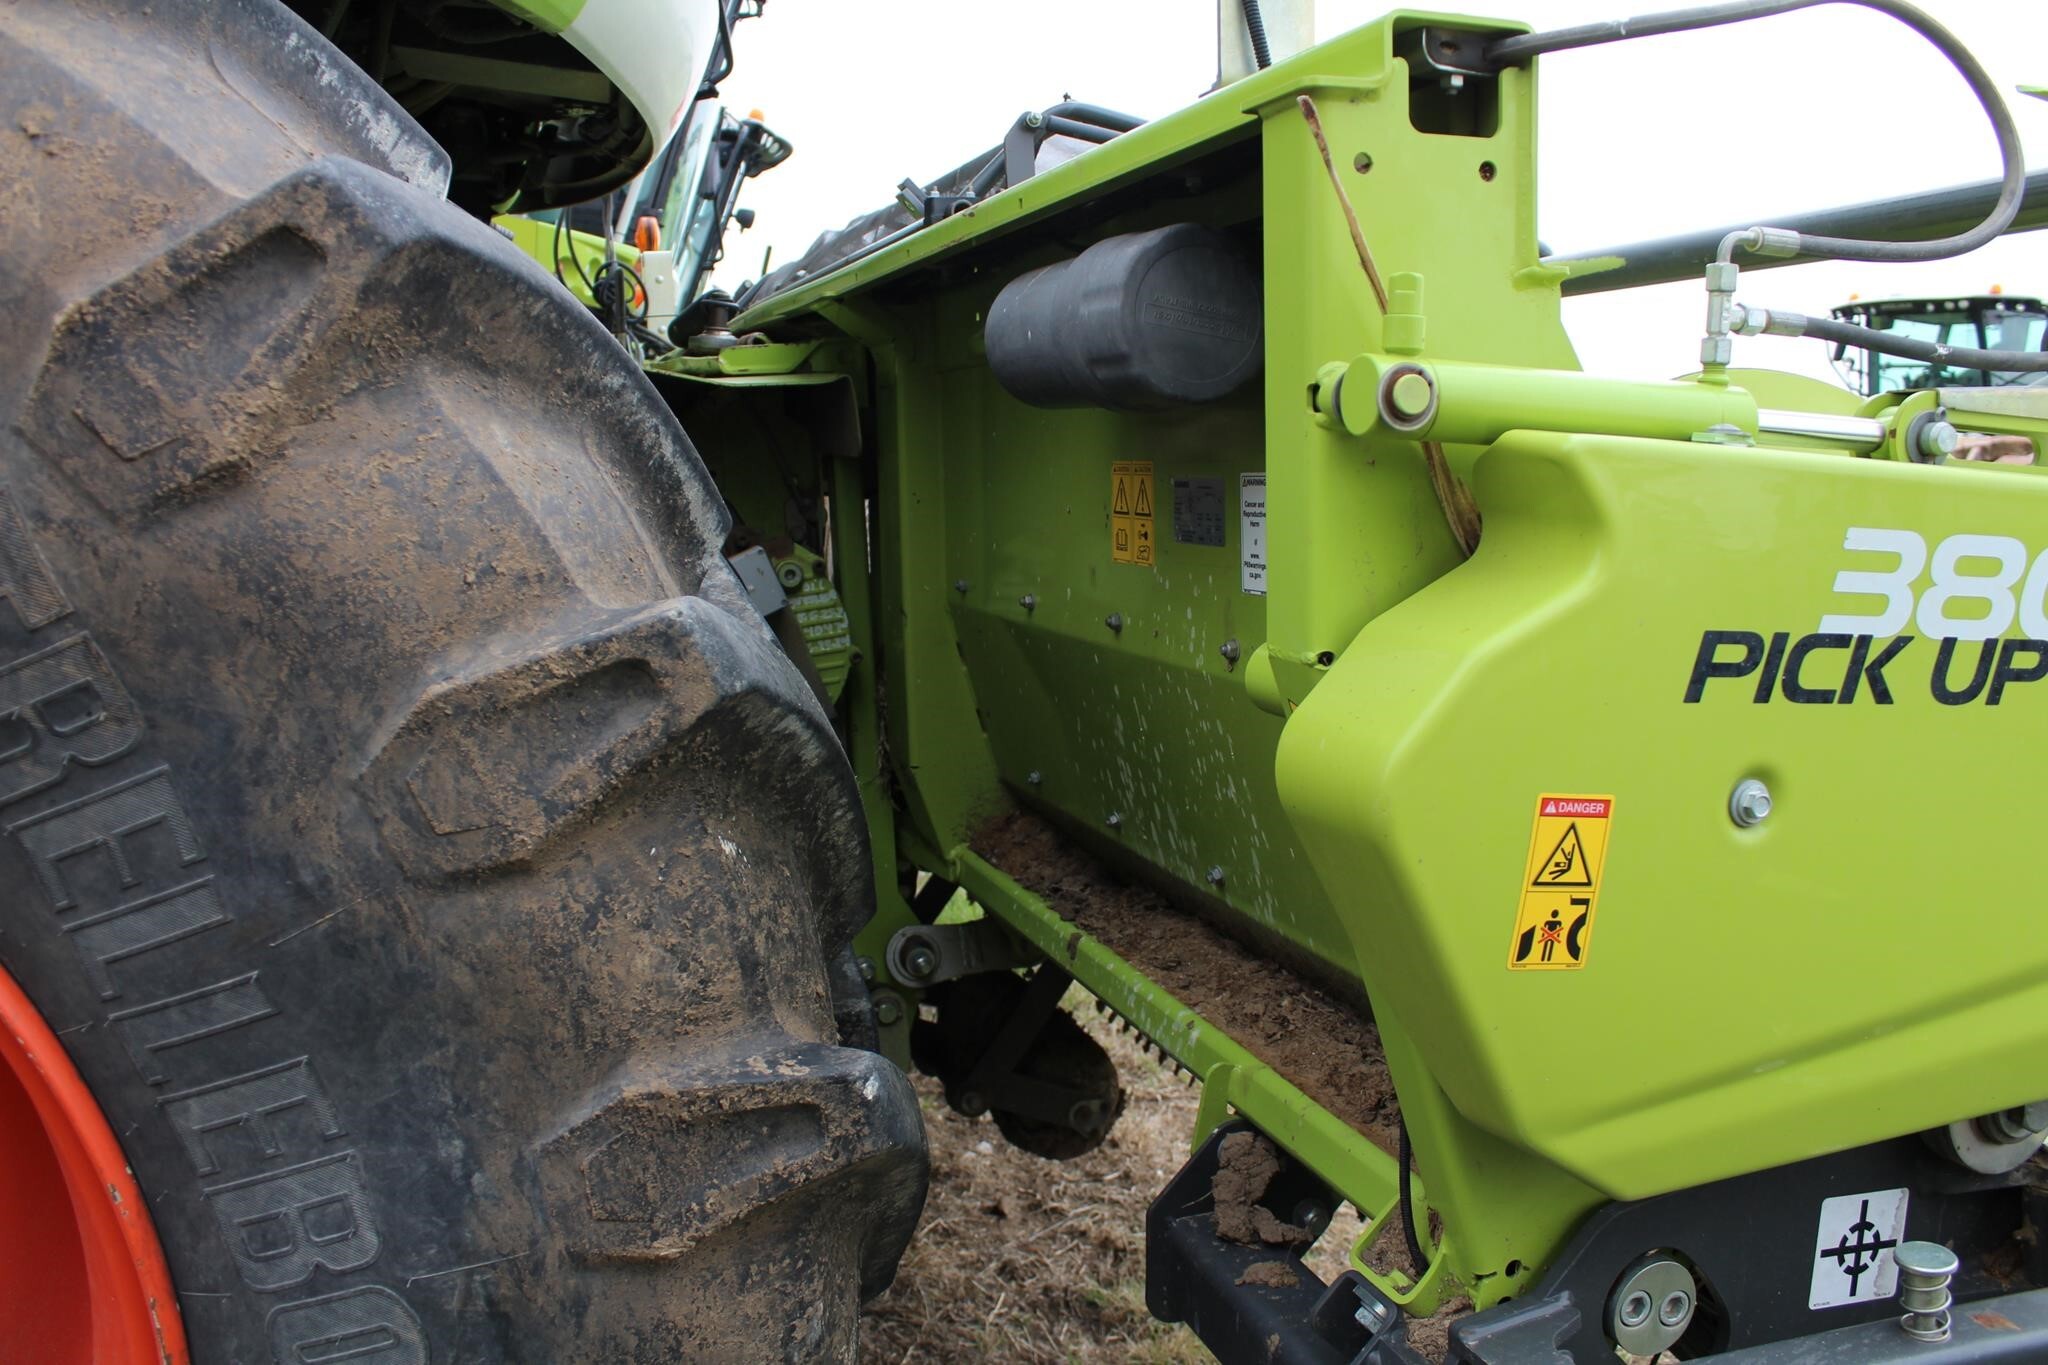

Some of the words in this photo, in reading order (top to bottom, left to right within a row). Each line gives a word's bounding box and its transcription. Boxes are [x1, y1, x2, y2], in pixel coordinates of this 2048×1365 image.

[1683, 630, 1915, 704] PICK
[1930, 637, 2048, 706] UP
[1558, 802, 1605, 814] DANGER
